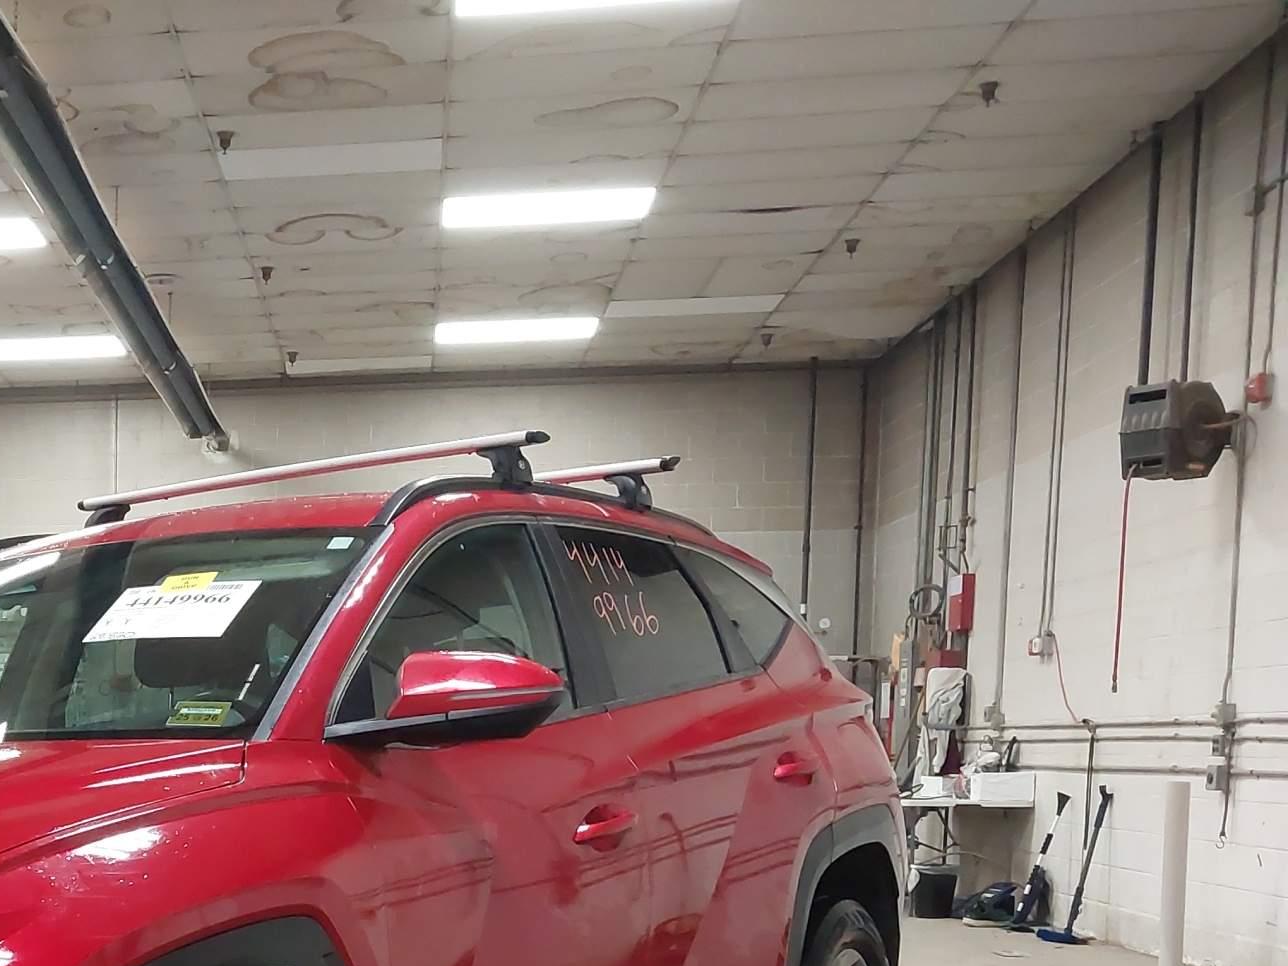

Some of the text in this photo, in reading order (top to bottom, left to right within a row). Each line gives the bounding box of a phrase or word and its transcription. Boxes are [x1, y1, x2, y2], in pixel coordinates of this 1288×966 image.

[562, 539, 635, 587] 4414
[126, 593, 232, 608] 44149966
[593, 590, 660, 637] 9966
